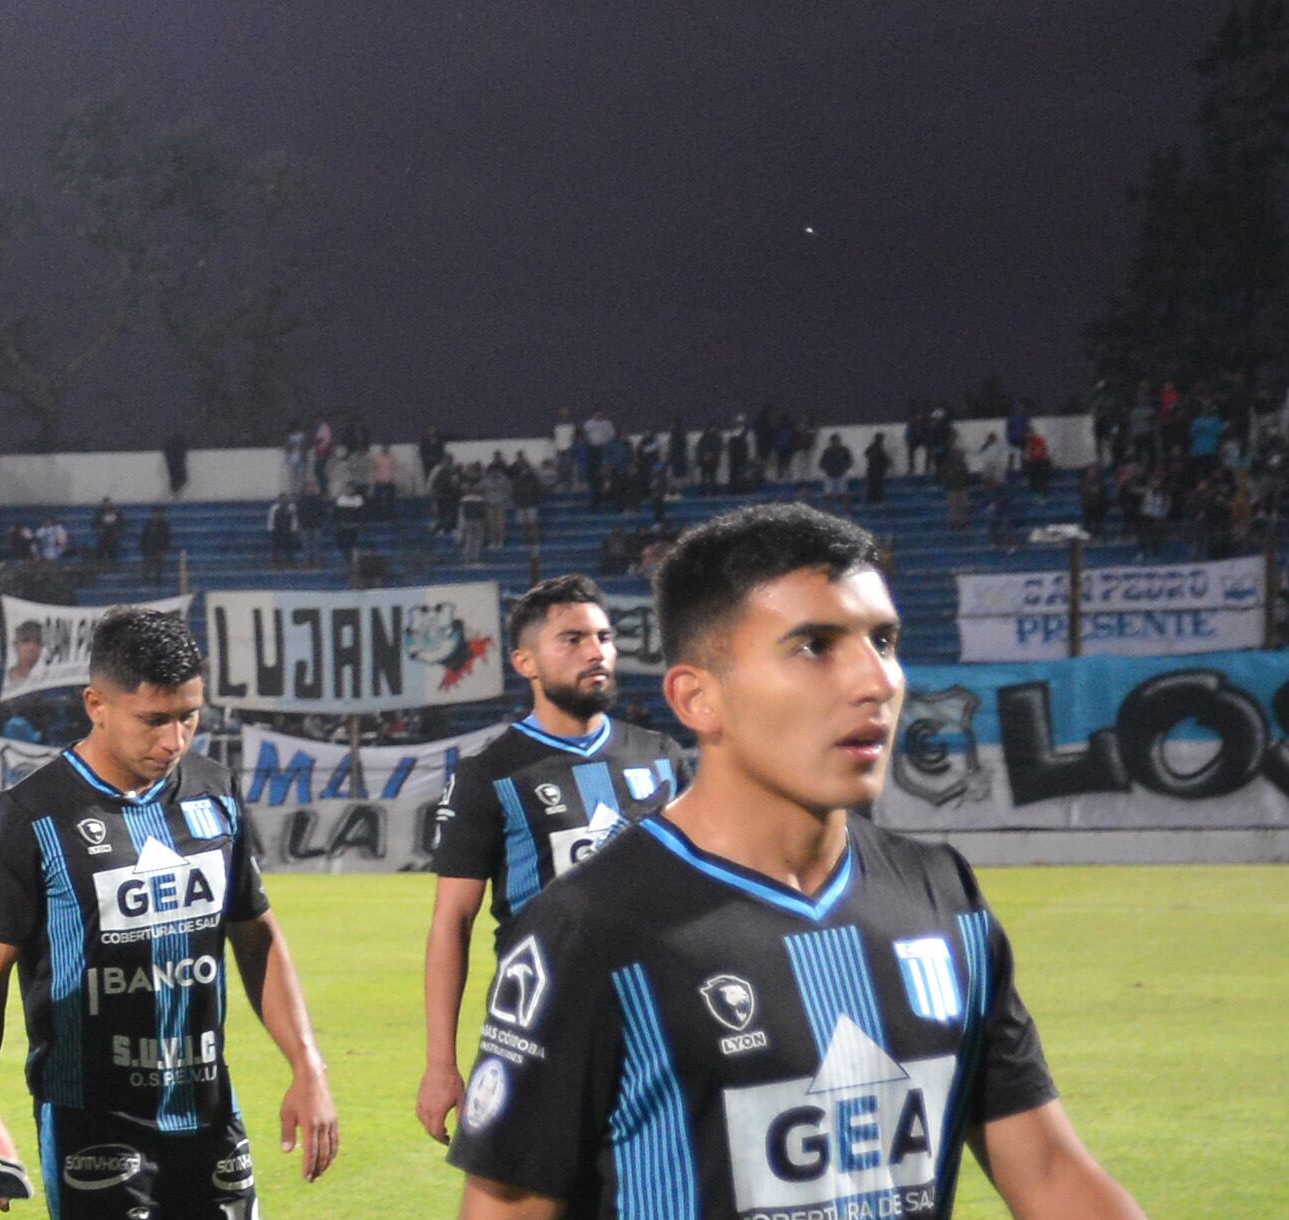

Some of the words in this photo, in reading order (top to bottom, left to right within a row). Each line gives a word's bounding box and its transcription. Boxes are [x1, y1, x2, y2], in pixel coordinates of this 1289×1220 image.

[1016, 608, 1216, 645] PRSENTE
[214, 604, 404, 699] LUJAN
[997, 668, 1289, 807] LO
[116, 867, 215, 918] GEA
[101, 924, 177, 945] COBERTURA
[179, 921, 195, 934] DE
[723, 1032, 766, 1053] LYON
[765, 1087, 933, 1183] GEA
[879, 1194, 903, 1218] DE
